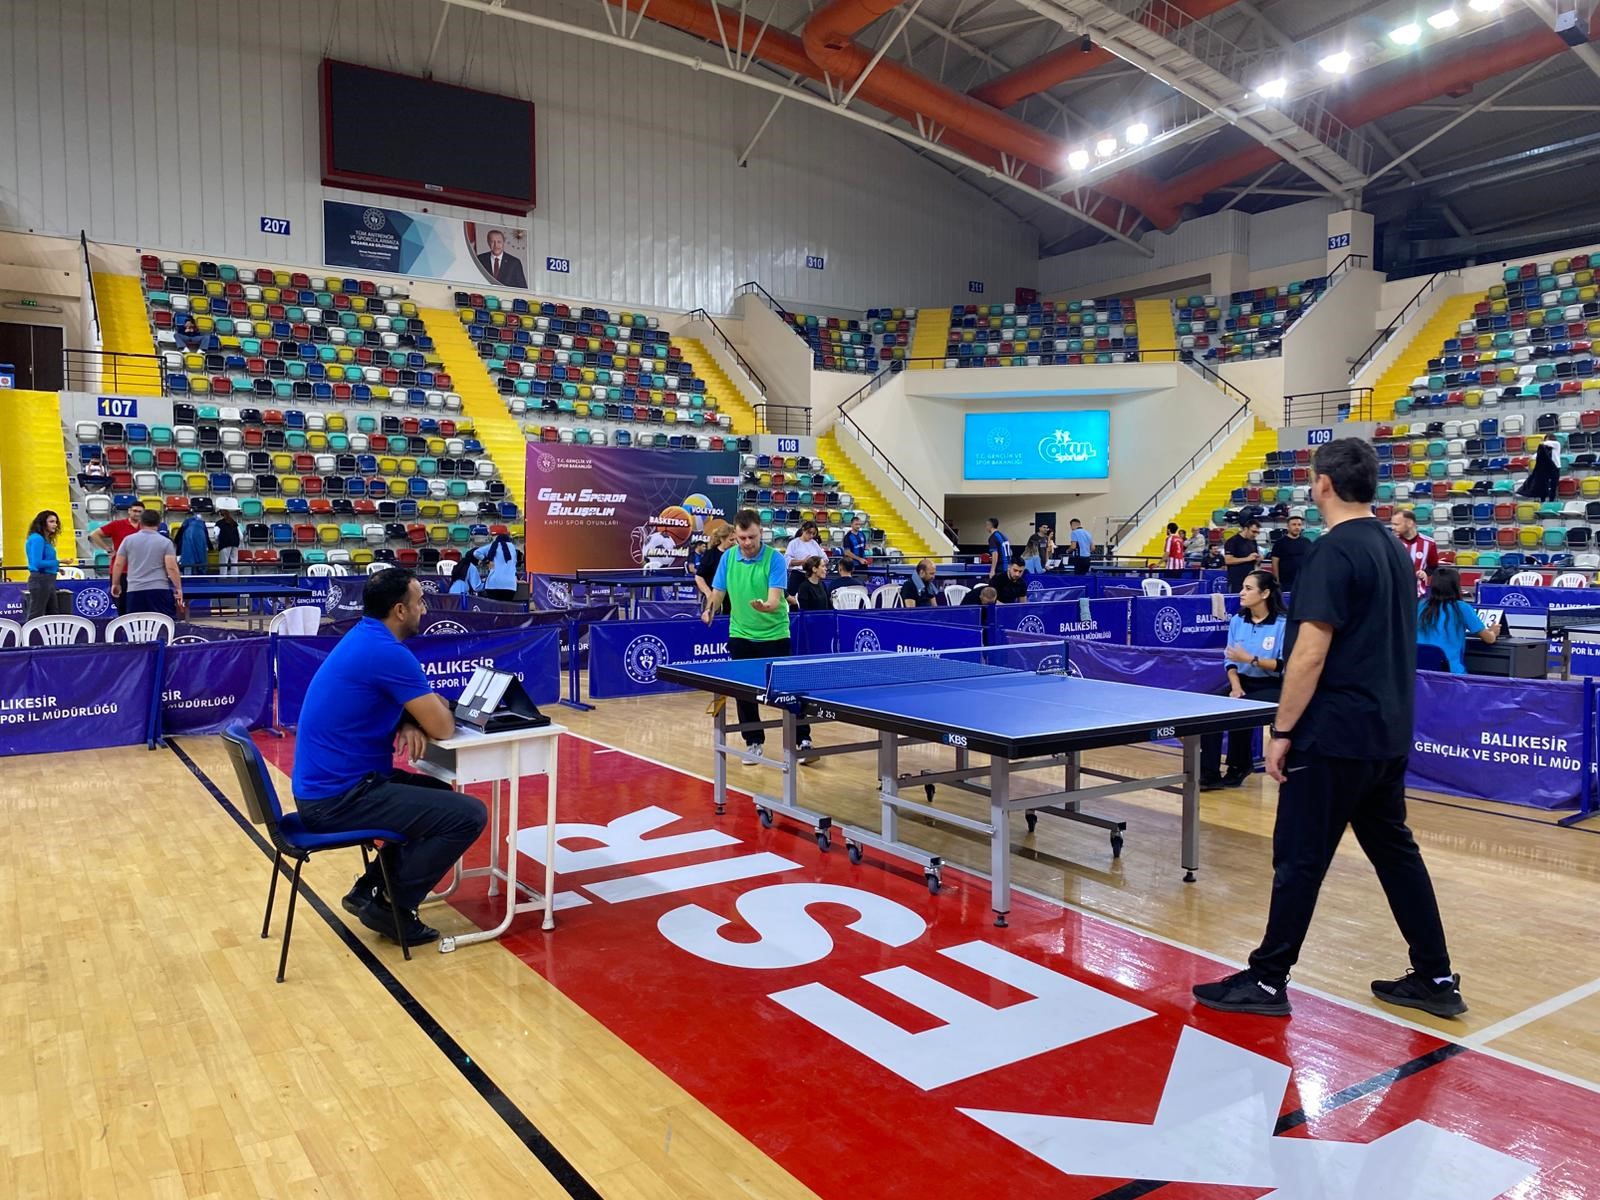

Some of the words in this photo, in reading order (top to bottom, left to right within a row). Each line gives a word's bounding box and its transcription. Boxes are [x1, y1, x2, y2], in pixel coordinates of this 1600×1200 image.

[264, 219, 287, 234] 207
[1329, 235, 1348, 249] 312
[549, 259, 568, 272] 208
[808, 256, 823, 269] 310
[102, 399, 132, 416] 107
[1310, 430, 1330, 444] 109
[780, 439, 797, 452] 108
[1046, 441, 1096, 457] OKUL
[691, 506, 725, 516] VOLEYBOL
[586, 519, 619, 527] OYUNLARI
[649, 516, 689, 527] BASKETBOL
[694, 642, 728, 656] BALIK
[436, 678, 459, 689] SPOR
[161, 688, 181, 702] SİR
[0, 695, 57, 710] LIKESİR
[0, 713, 25, 724] POR
[28, 711, 40, 722] İL
[42, 702, 118, 720] MÜDÜRLÜĞÜ
[948, 732, 968, 747] KBS
[1156, 726, 1175, 739] KBS
[1480, 732, 1568, 753] BALIKESİR
[1415, 740, 1470, 758] GENÇLİK
[1472, 749, 1490, 761] VE
[1493, 751, 1530, 766] SPOR
[1533, 752, 1547, 767] İL
